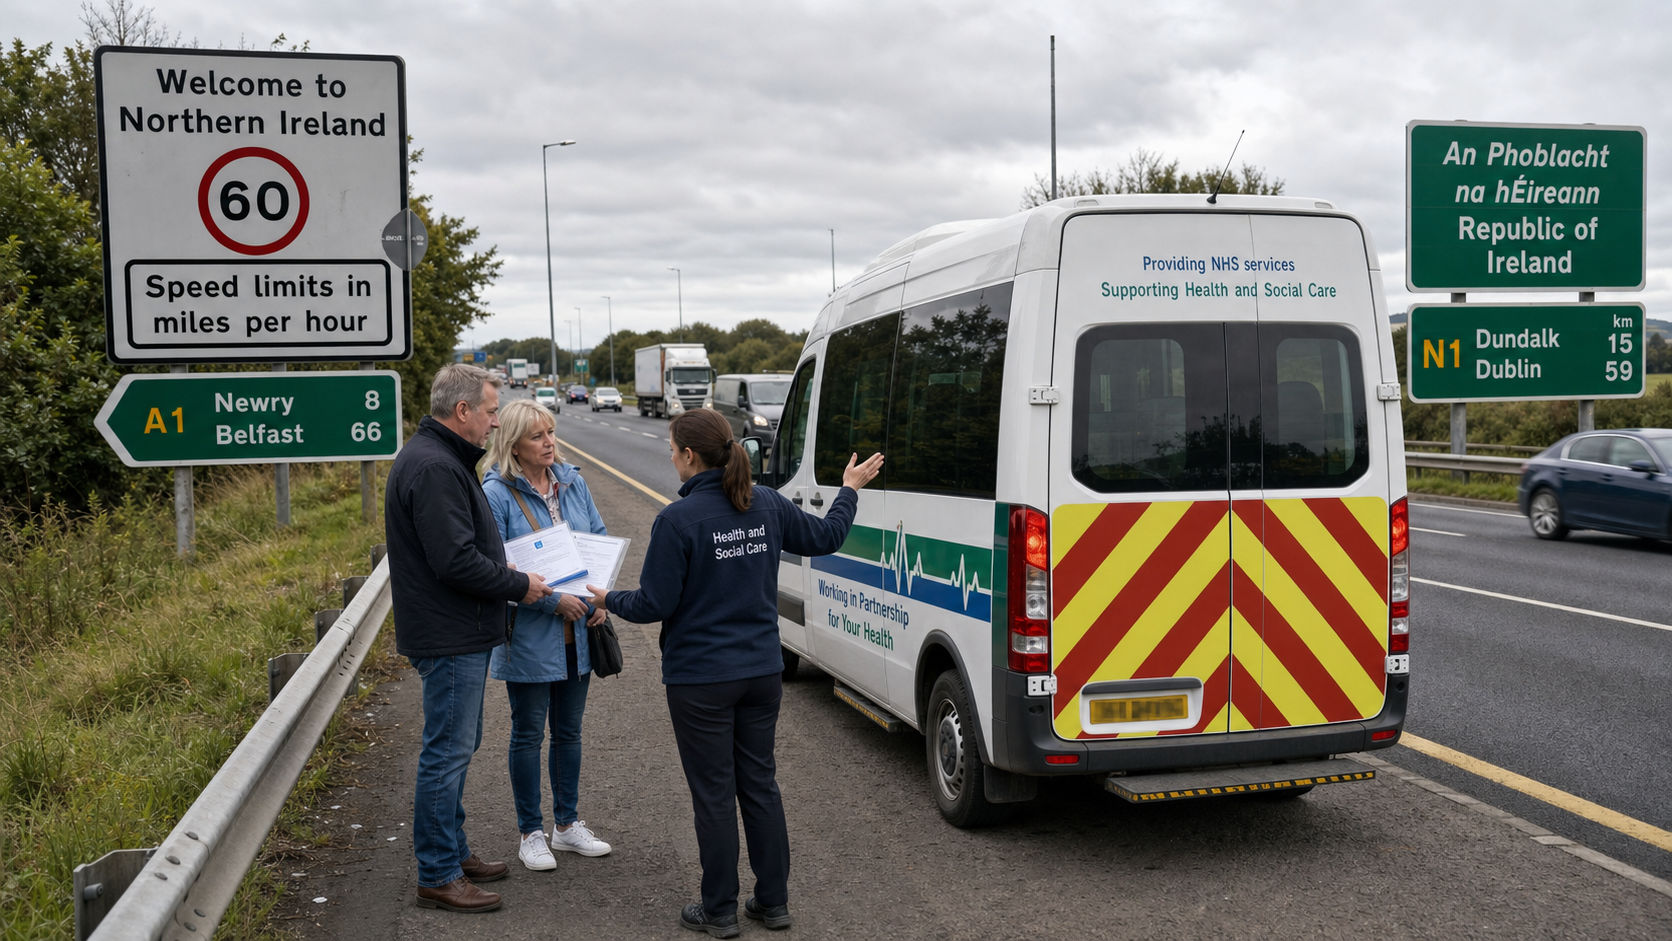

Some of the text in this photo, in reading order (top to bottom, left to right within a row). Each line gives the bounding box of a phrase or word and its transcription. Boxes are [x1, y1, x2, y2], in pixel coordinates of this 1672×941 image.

[156, 68, 347, 99] Welcome to
[119, 106, 386, 137] Northern Ireland
[1442, 141, 1610, 168] An Phoblacht
[219, 180, 290, 222] 60
[1455, 174, 1600, 204] na hÉireann
[1458, 216, 1599, 246] Republic of
[1142, 256, 1295, 274] Providing NHS services
[1487, 250, 1572, 274] Ireland
[145, 274, 371, 302] Speed limits in
[1101, 282, 1337, 300] Supporting Health and Social Care
[153, 310, 368, 338] miles per hour
[1613, 314, 1633, 328] km
[1423, 339, 1460, 369] N1
[1476, 328, 1633, 354] Dundalk 15
[1476, 359, 1633, 381] Dublin 59
[214, 389, 381, 416] Newry 8
[143, 407, 184, 434] A1
[215, 421, 382, 445] Belfast 66
[712, 524, 766, 544] Health and
[715, 542, 768, 560] Social Care
[818, 578, 909, 630] Working in Partnership
[828, 608, 894, 651] for Your Health
